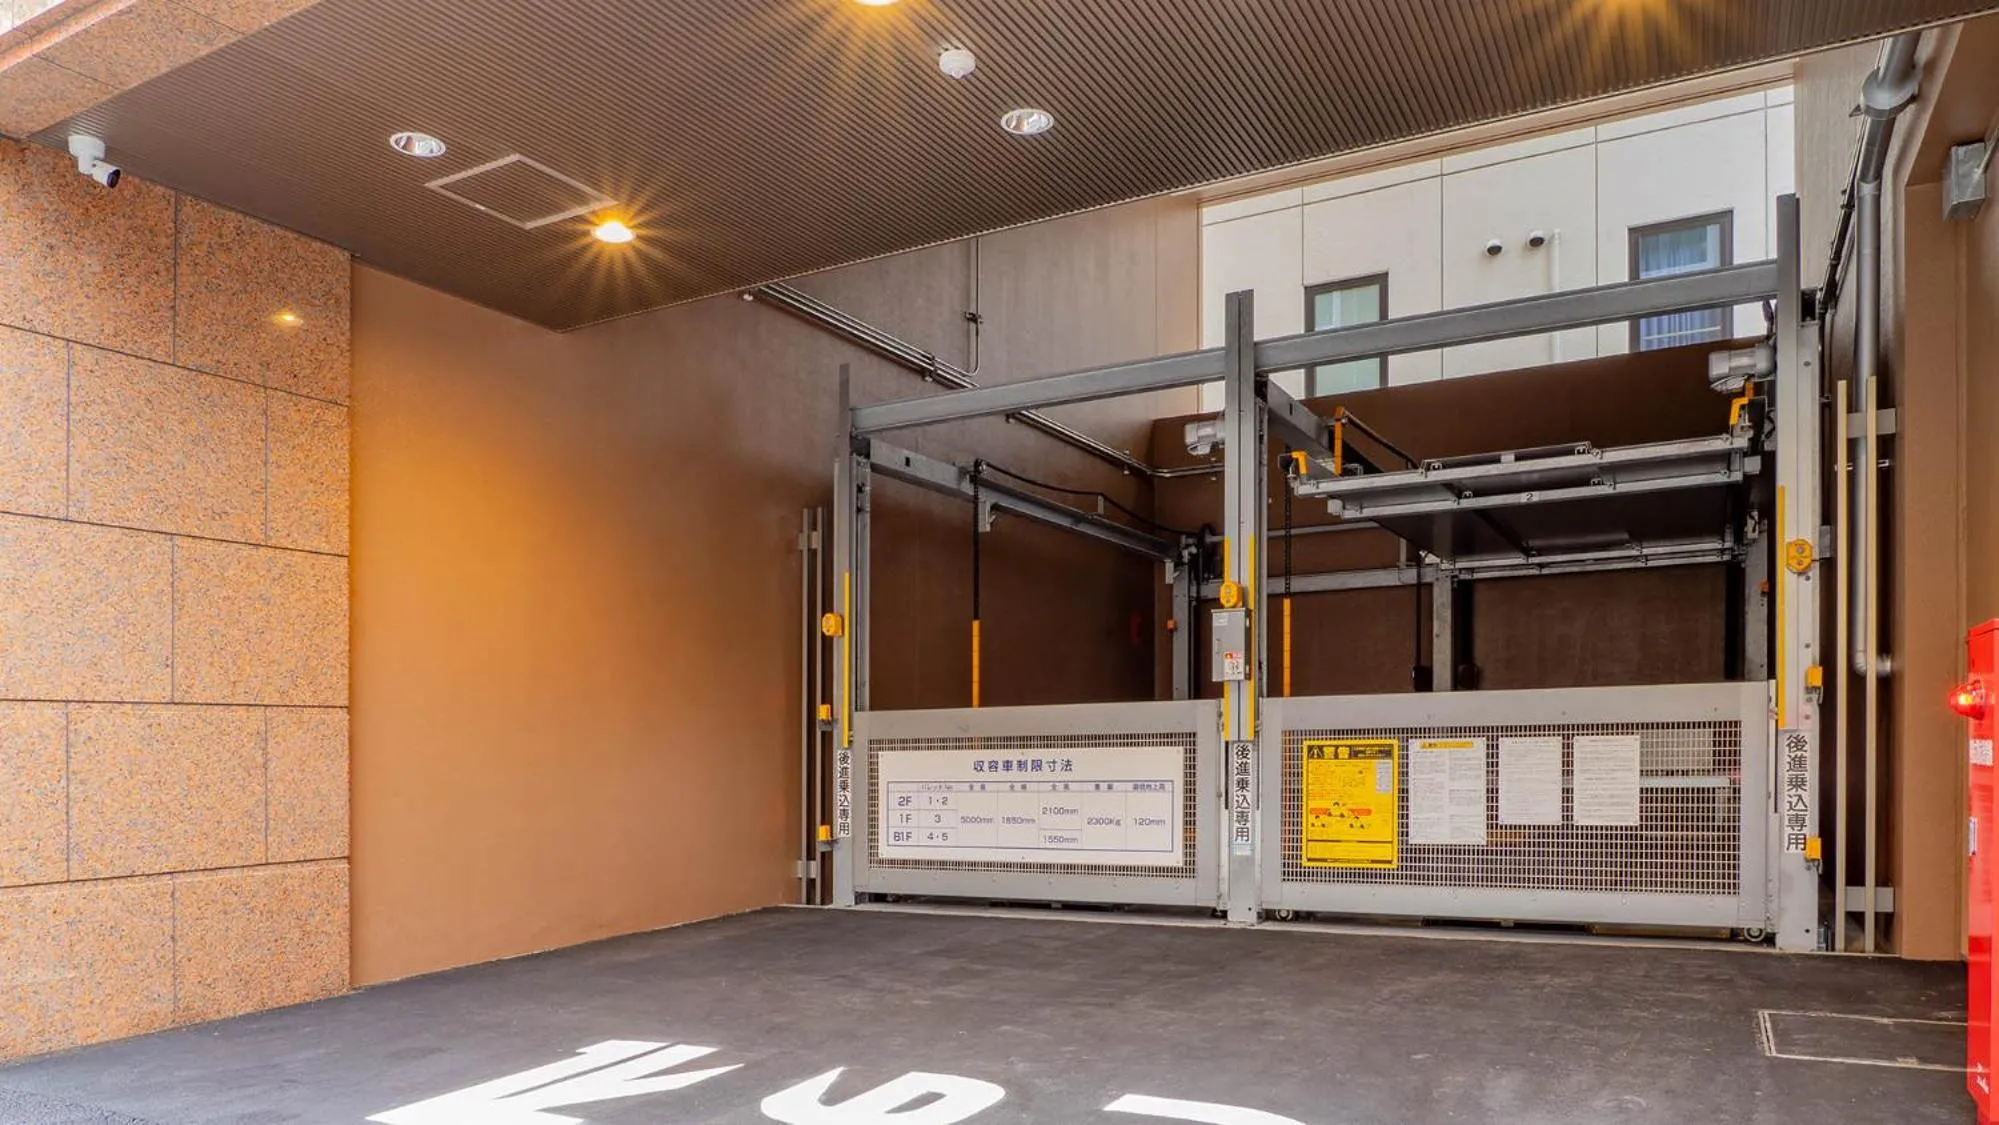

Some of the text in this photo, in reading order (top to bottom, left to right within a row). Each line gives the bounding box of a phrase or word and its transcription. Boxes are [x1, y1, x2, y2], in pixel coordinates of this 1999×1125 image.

[1526, 492, 1534, 502] 2
[973, 759, 1073, 773] 収容車制限寸法
[838, 751, 850, 836] 後進乗込専用
[1234, 743, 1251, 843] 後進乗込専用
[1786, 733, 1808, 852] 後進乗込専用
[898, 796, 912, 807] 2F
[1041, 806, 1079, 815] 2100mm
[900, 814, 912, 824] 1F
[934, 814, 941, 823] 3
[1133, 817, 1166, 826] 120mm
[893, 831, 912, 842] B1F
